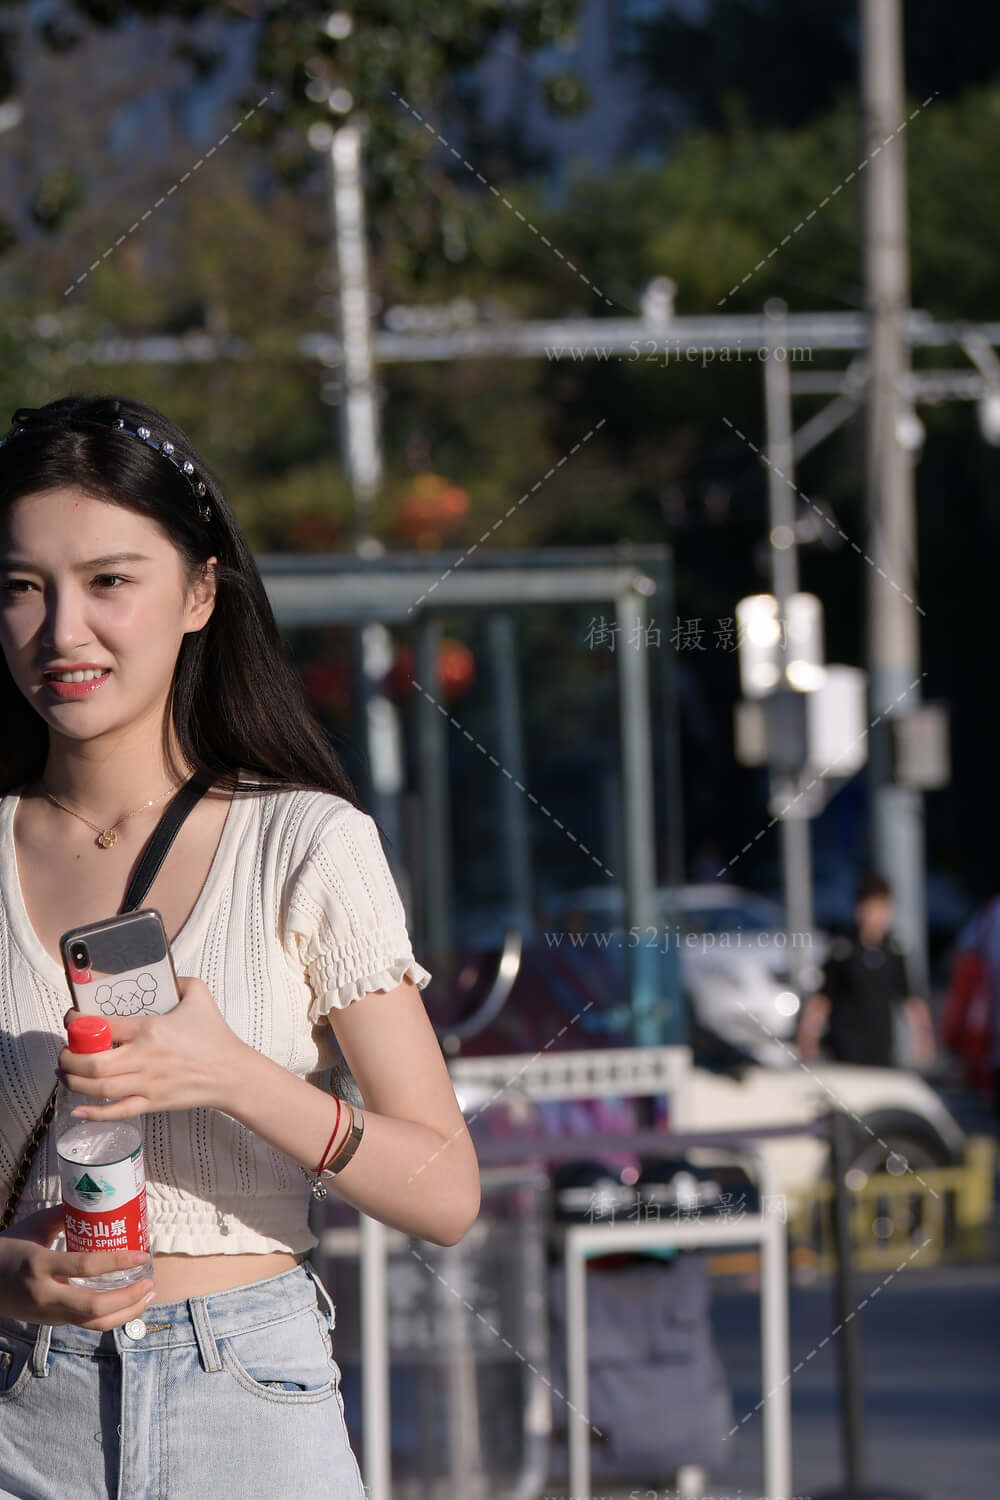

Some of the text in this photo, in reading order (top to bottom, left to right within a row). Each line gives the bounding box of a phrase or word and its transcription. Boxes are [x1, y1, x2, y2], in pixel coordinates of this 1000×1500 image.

[66, 1214, 127, 1237] 农夫山泉
[96, 1236, 128, 1248] SPRING
